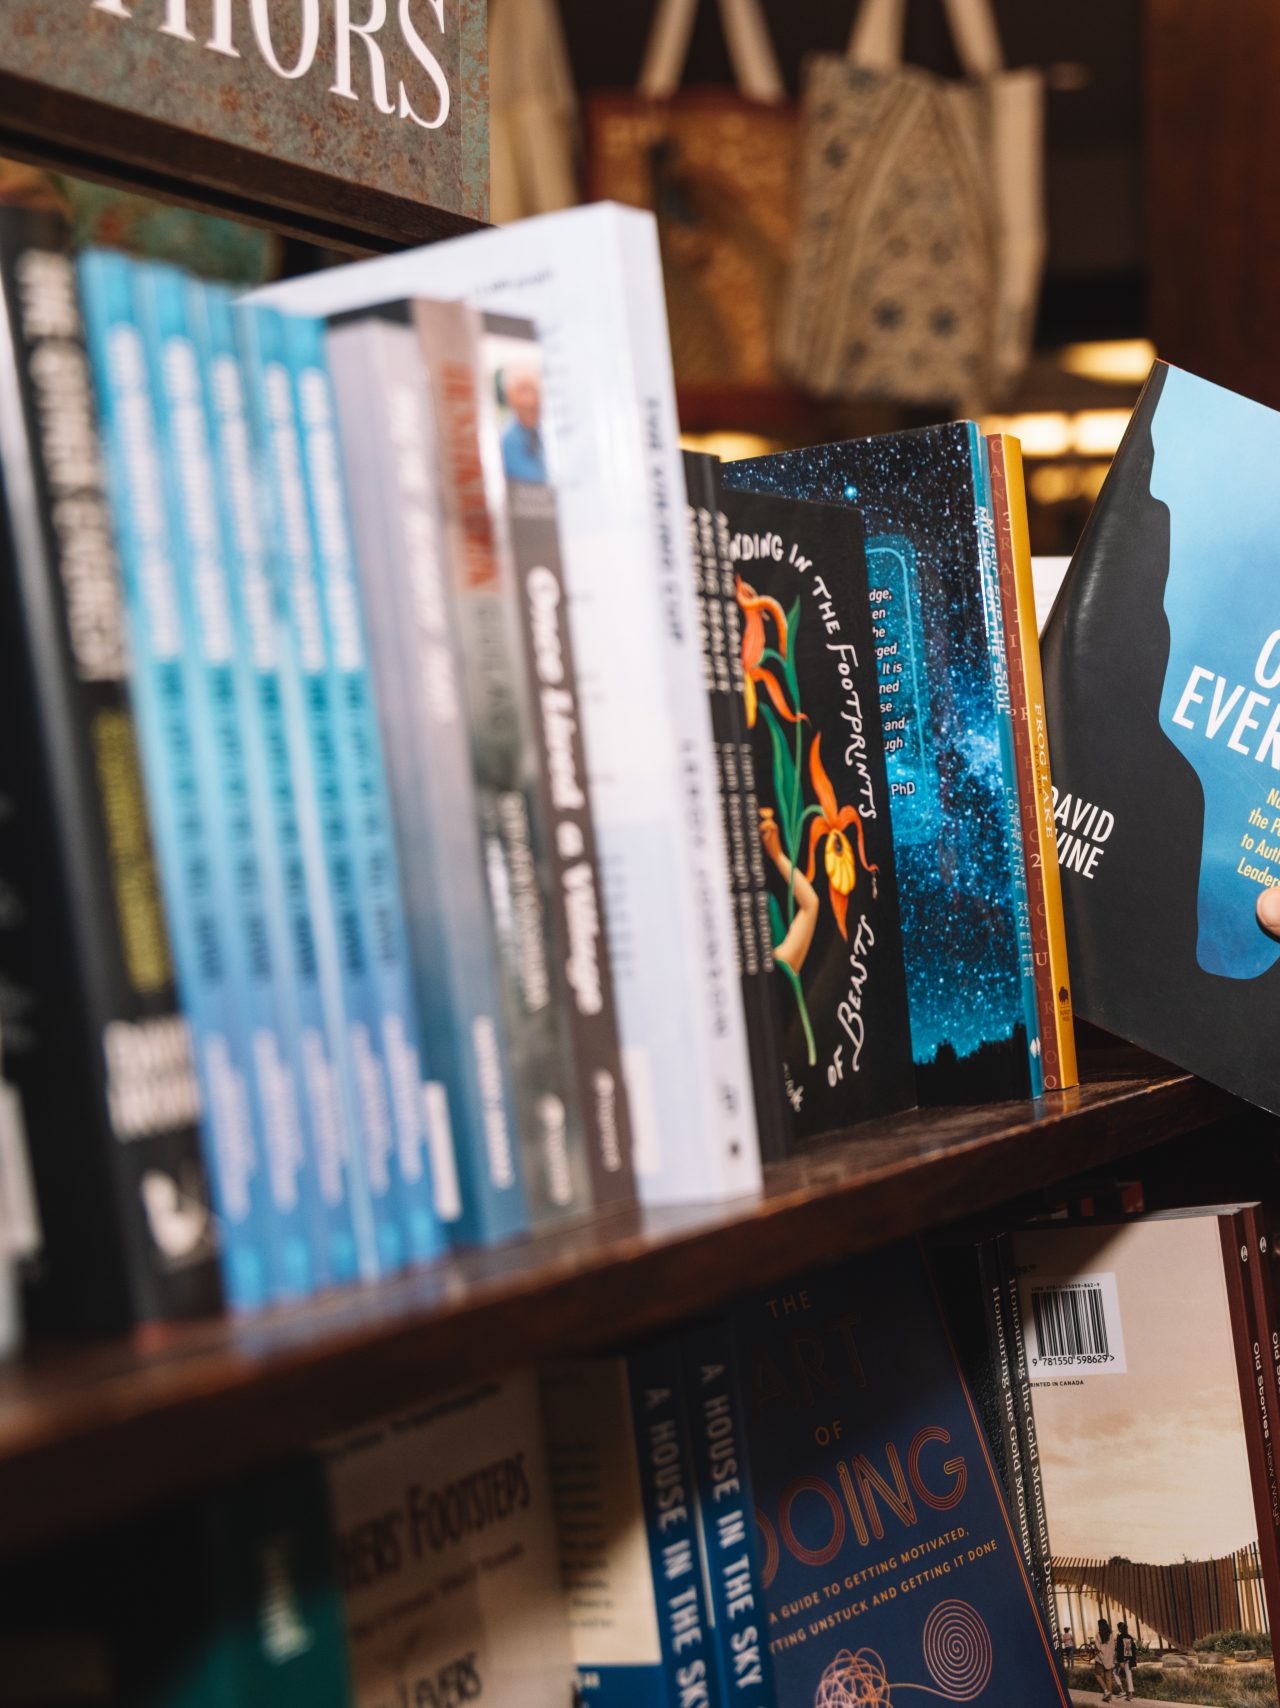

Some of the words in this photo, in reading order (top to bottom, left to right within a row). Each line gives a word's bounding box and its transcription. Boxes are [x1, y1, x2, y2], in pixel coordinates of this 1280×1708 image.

[789, 543, 813, 573] IN
[812, 575, 841, 635] THE
[893, 661, 903, 673] is
[993, 662, 1007, 714] SOUL
[826, 643, 877, 820] FOOTPRINTS
[884, 717, 906, 731] and
[891, 782, 916, 796] PhD
[1034, 703, 1047, 766] FROG
[1041, 775, 1053, 839] LAKE
[1248, 808, 1269, 829] the
[1240, 833, 1255, 851] to
[766, 1289, 814, 1320] THE
[991, 1285, 1011, 1389] Honouring
[1009, 1278, 1027, 1381] Honouring
[1272, 1331, 1280, 1360] Old
[700, 1362, 726, 1385] A
[1032, 1358, 1038, 1367] 9
[1042, 1356, 1073, 1367] 781550
[1077, 1354, 1108, 1365] 598629
[1253, 1341, 1263, 1372] Old
[645, 1386, 673, 1411] A
[1020, 1381, 1031, 1414] the
[1060, 1379, 1084, 1387] CANADA
[1005, 1391, 1014, 1424] the
[1257, 1374, 1270, 1439] Stories
[704, 1393, 742, 1505] HOUSE
[814, 1419, 842, 1447] OF
[1009, 1426, 1021, 1472] Gold
[1026, 1416, 1039, 1463] Gold
[649, 1418, 689, 1535] HOUSE
[716, 1508, 747, 1551] IN
[1015, 1477, 1031, 1567] Mountain
[1032, 1465, 1049, 1556] Mountain
[659, 1537, 695, 1583] IN
[769, 1611, 778, 1624] A
[781, 1590, 821, 1618] GUIDE
[822, 1583, 841, 1598] TO
[844, 1559, 898, 1589] GETTING
[900, 1527, 970, 1564] MOTIVATED,
[721, 1551, 756, 1623] THE
[809, 1600, 869, 1636] UNSTUCK
[872, 1586, 898, 1606] AND
[901, 1561, 951, 1593] GETTING
[953, 1554, 966, 1568] IT
[967, 1539, 998, 1562] DONE
[1043, 1560, 1060, 1651] Dreamers
[667, 1583, 703, 1657] THE
[729, 1624, 764, 1690] SKY
[675, 1658, 711, 1708] SK
